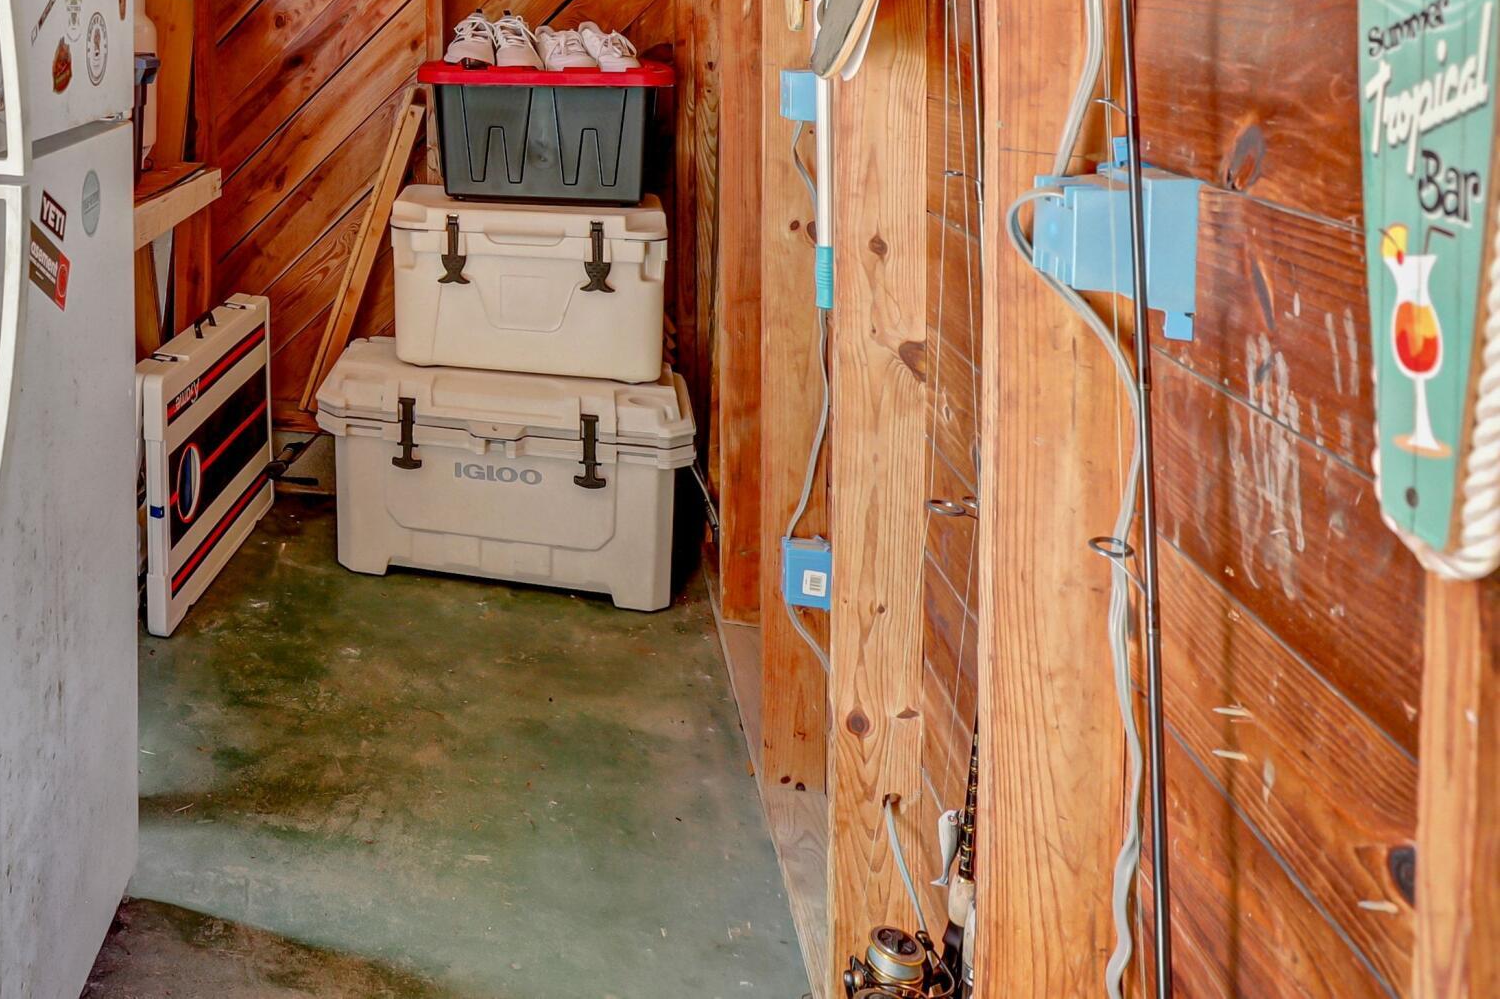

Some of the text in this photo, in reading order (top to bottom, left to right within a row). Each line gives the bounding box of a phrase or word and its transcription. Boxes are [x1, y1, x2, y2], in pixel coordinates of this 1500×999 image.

[1365, 1, 1493, 177] Tropical
[42, 195, 66, 237] YETI
[1418, 150, 1482, 224] Bar
[454, 461, 543, 487] IGLOO
